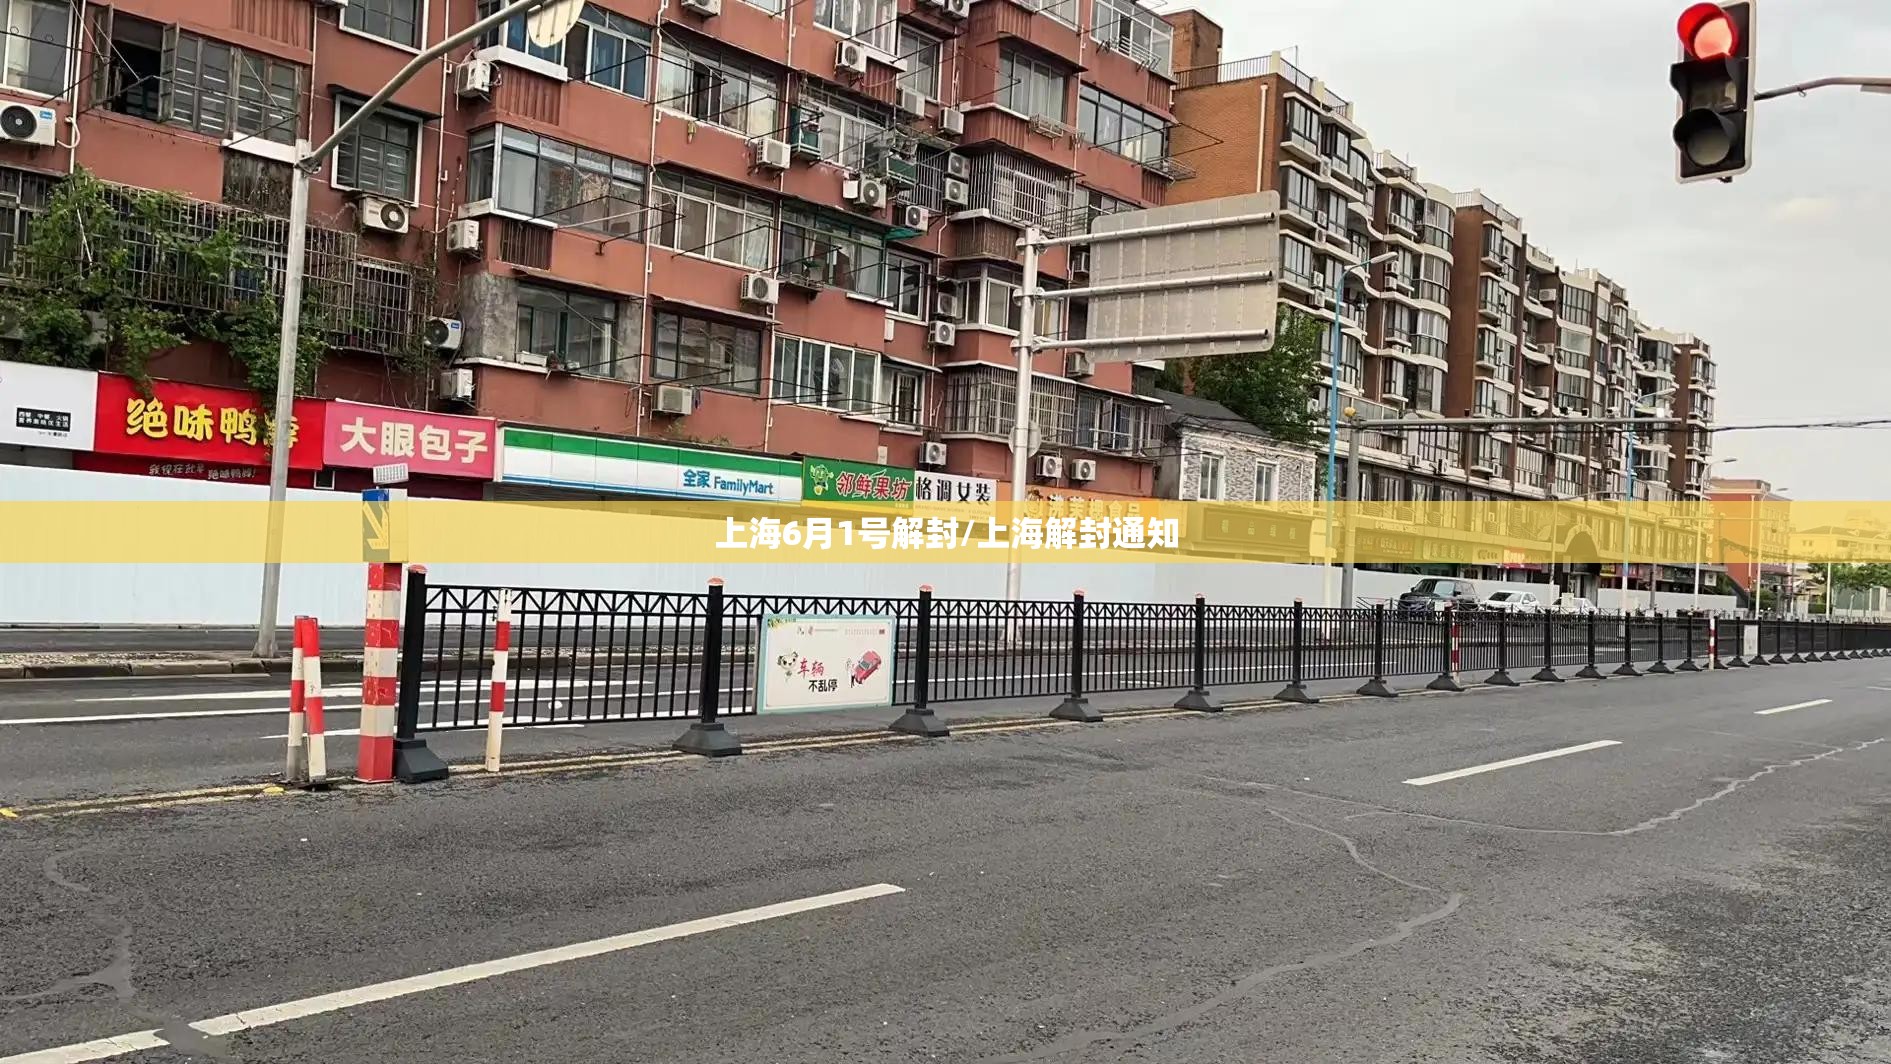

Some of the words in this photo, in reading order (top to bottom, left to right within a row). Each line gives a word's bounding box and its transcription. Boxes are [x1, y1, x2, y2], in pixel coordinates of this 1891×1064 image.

[340, 416, 488, 464] 大眼包子
[683, 469, 711, 488] 全家
[714, 476, 774, 496] FamilyMart
[836, 470, 912, 501] 邻鲜果坊
[915, 475, 991, 506] 格调女装
[797, 657, 825, 679] 车辆
[808, 678, 838, 693] 不乱停
